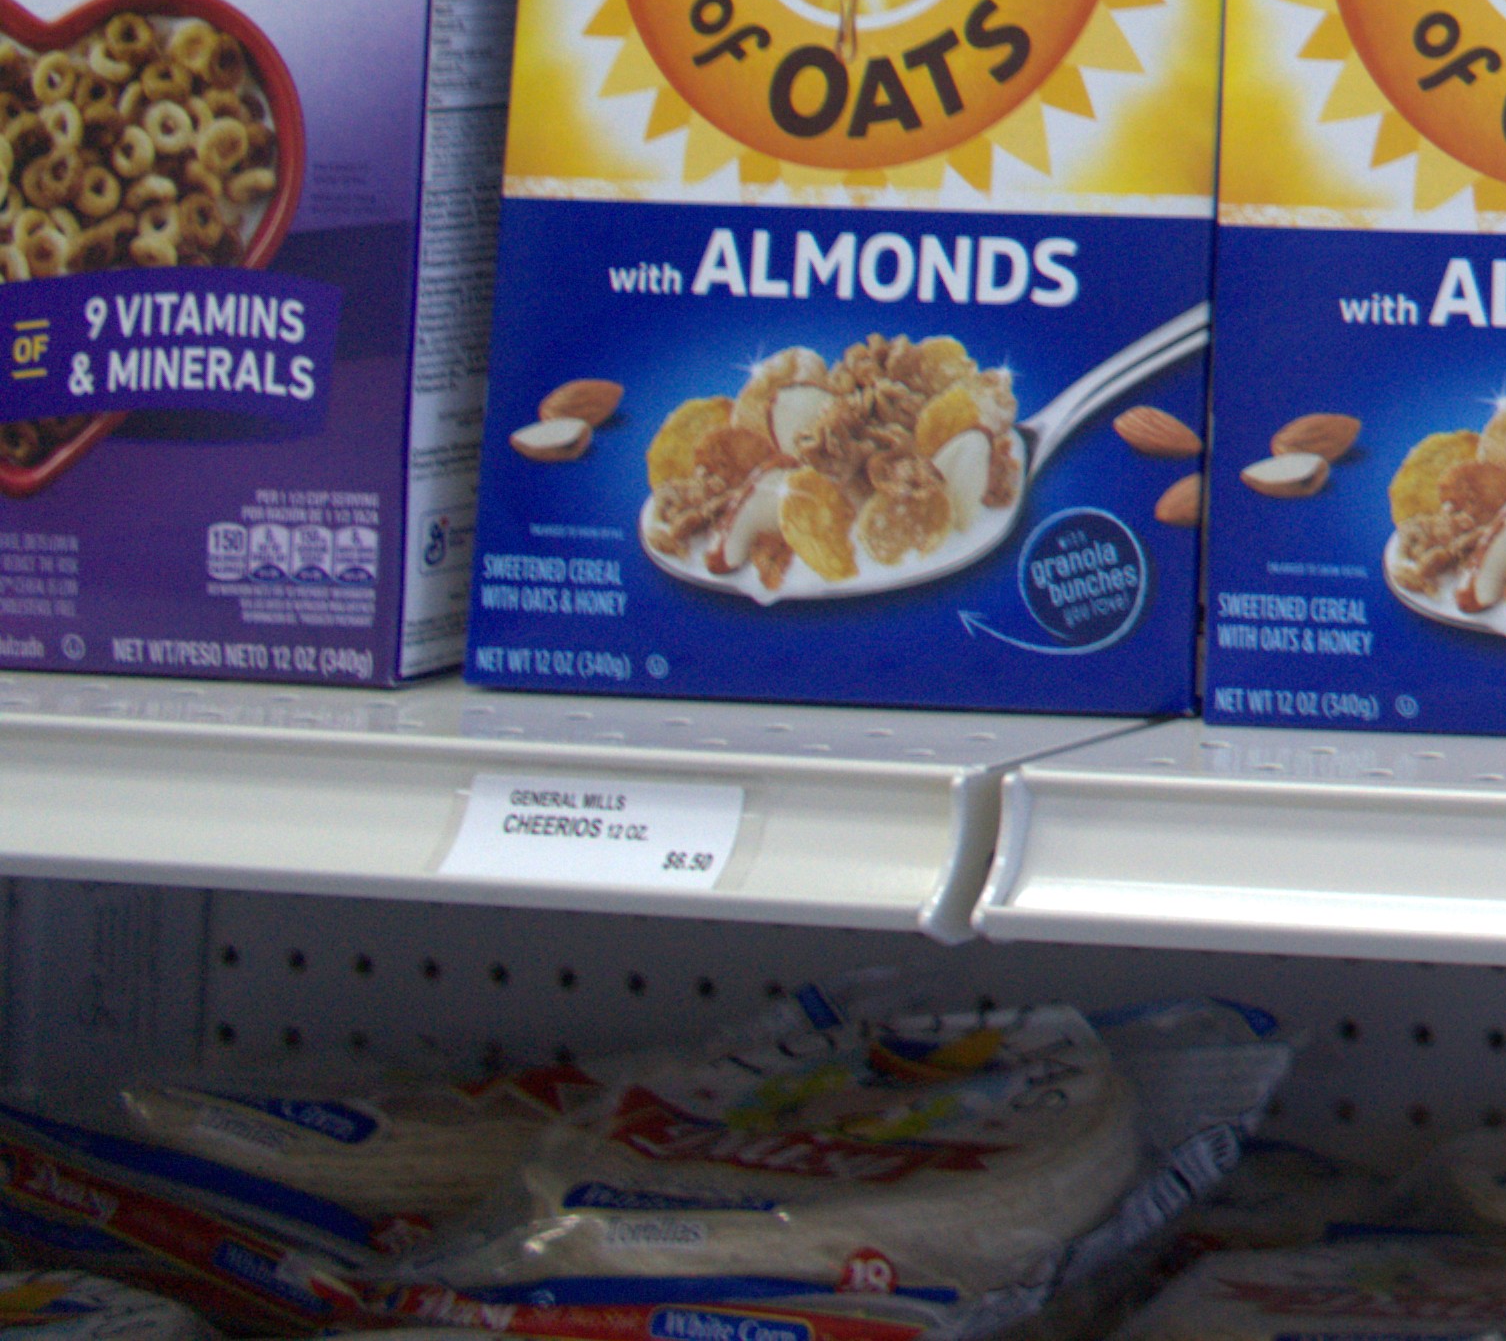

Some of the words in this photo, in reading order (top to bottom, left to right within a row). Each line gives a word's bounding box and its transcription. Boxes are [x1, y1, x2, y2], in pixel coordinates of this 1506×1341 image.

[608, 262, 683, 295] with
[691, 227, 1079, 307] ALMONDS
[85, 296, 107, 339] 9
[114, 293, 305, 343] VITAMINS
[1340, 292, 1419, 325] with
[13, 334, 49, 363] OF
[69, 352, 95, 397] &
[108, 349, 315, 401] MINERALS
[509, 789, 577, 811] GENERAL
[581, 792, 627, 813] MILLS
[502, 814, 602, 841] CHEERIOS
[607, 823, 623, 840] 12
